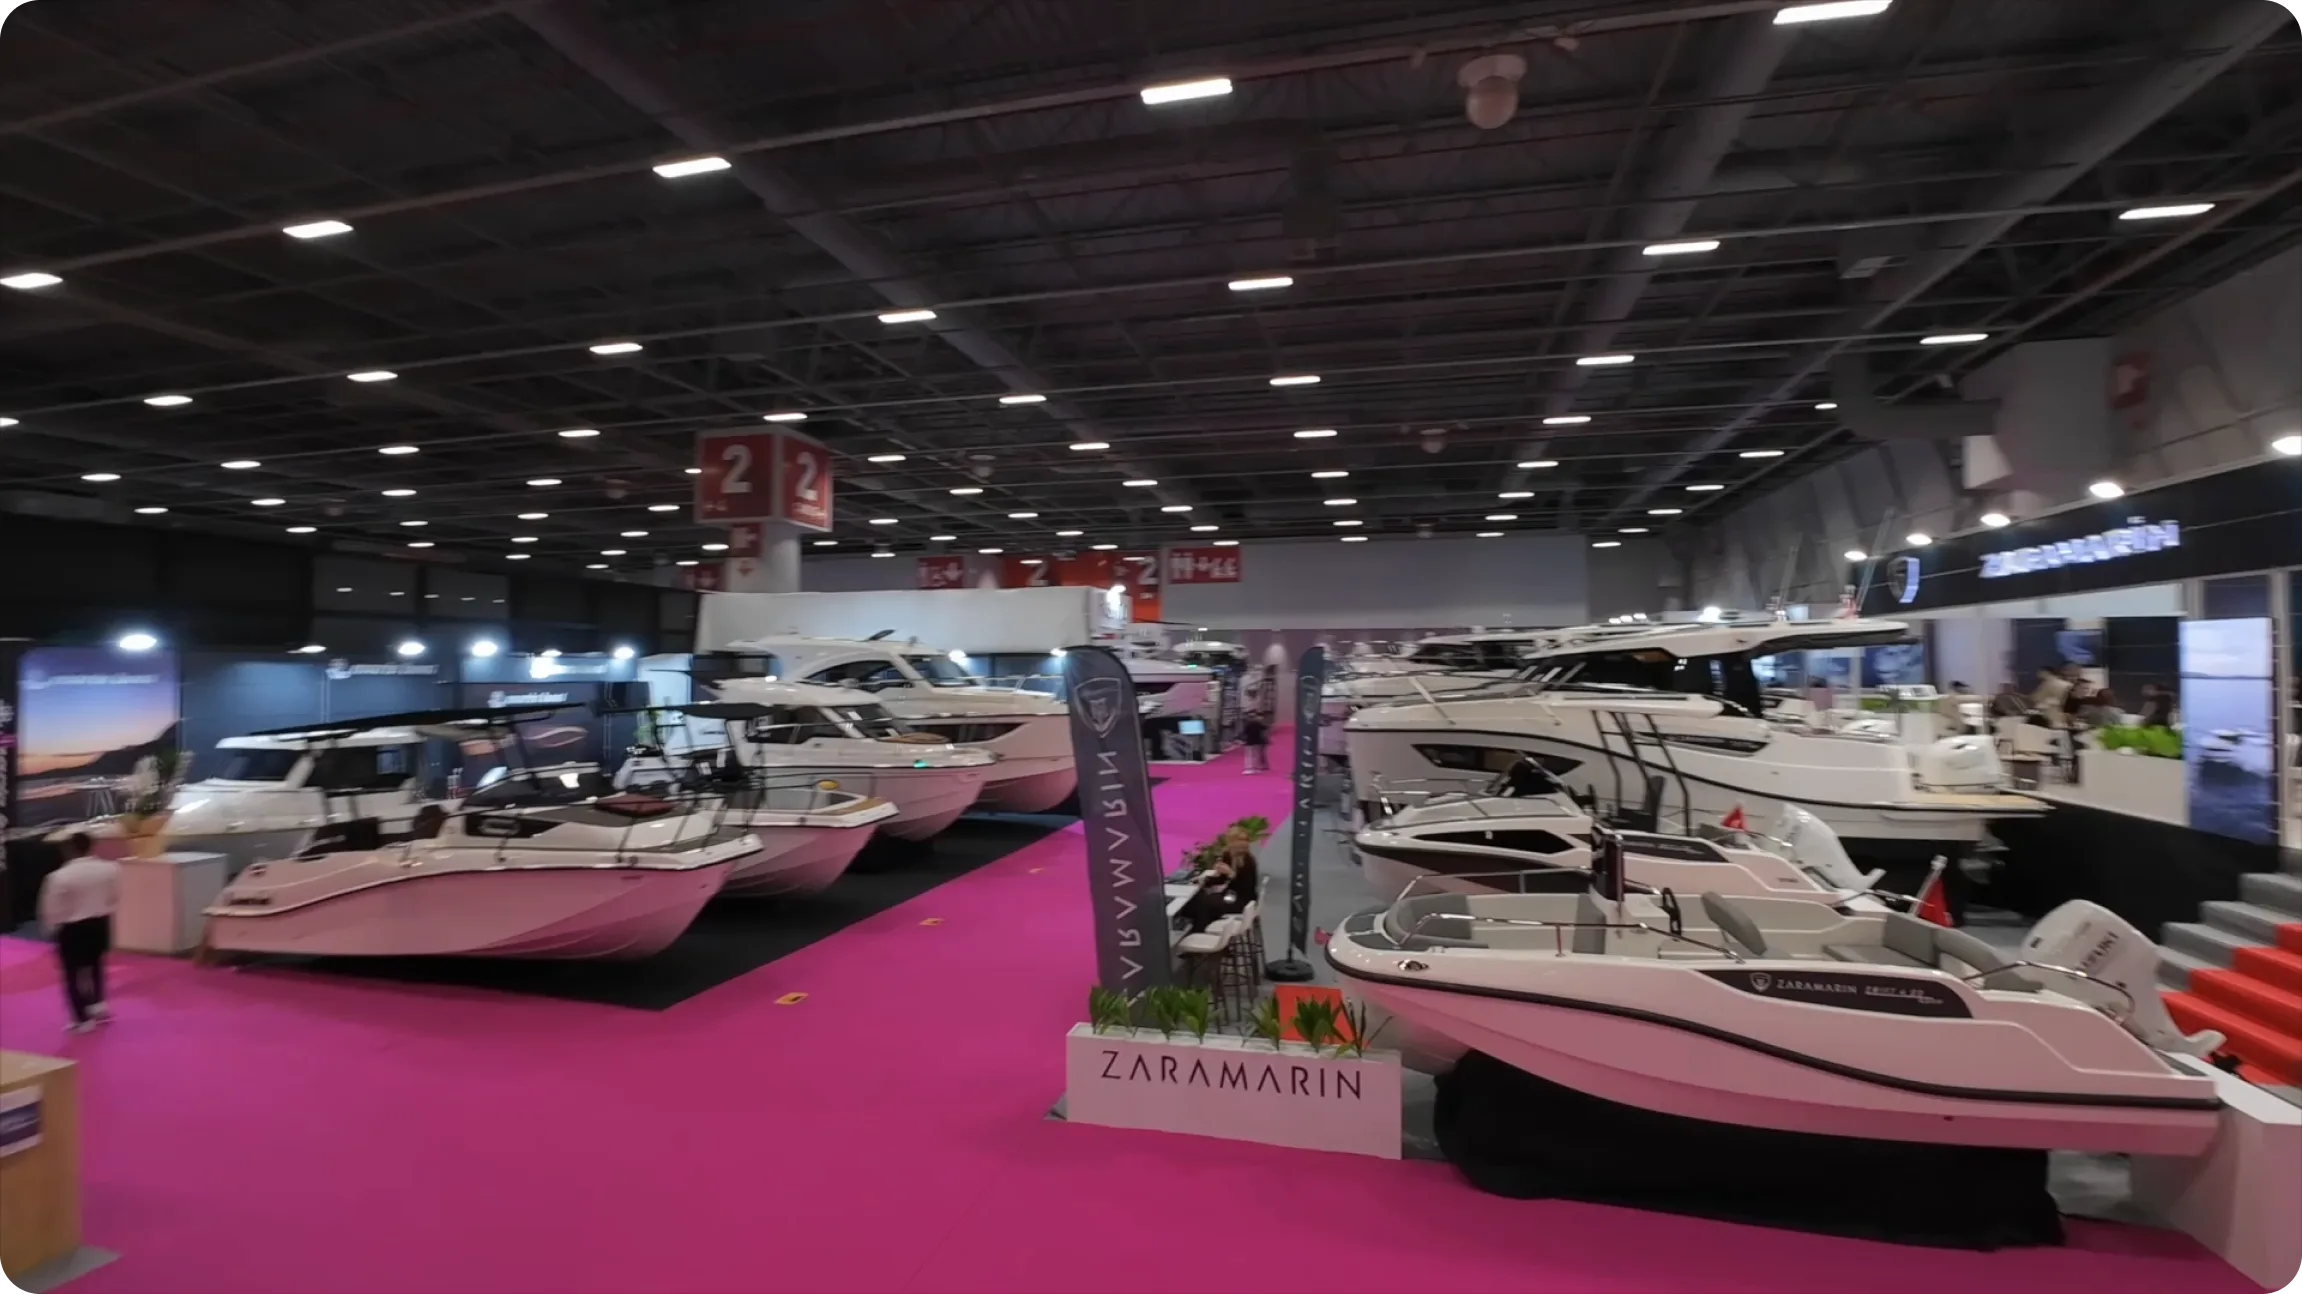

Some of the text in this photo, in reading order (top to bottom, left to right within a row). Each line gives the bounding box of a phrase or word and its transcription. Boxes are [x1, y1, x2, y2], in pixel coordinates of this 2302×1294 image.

[721, 444, 753, 494] 2
[795, 451, 818, 501] 2
[1029, 562, 1048, 586] 2
[1138, 556, 1157, 585] 2
[1776, 978, 1858, 995] ZARAMARIN
[1101, 1050, 1362, 1100] ZARAMARIN
